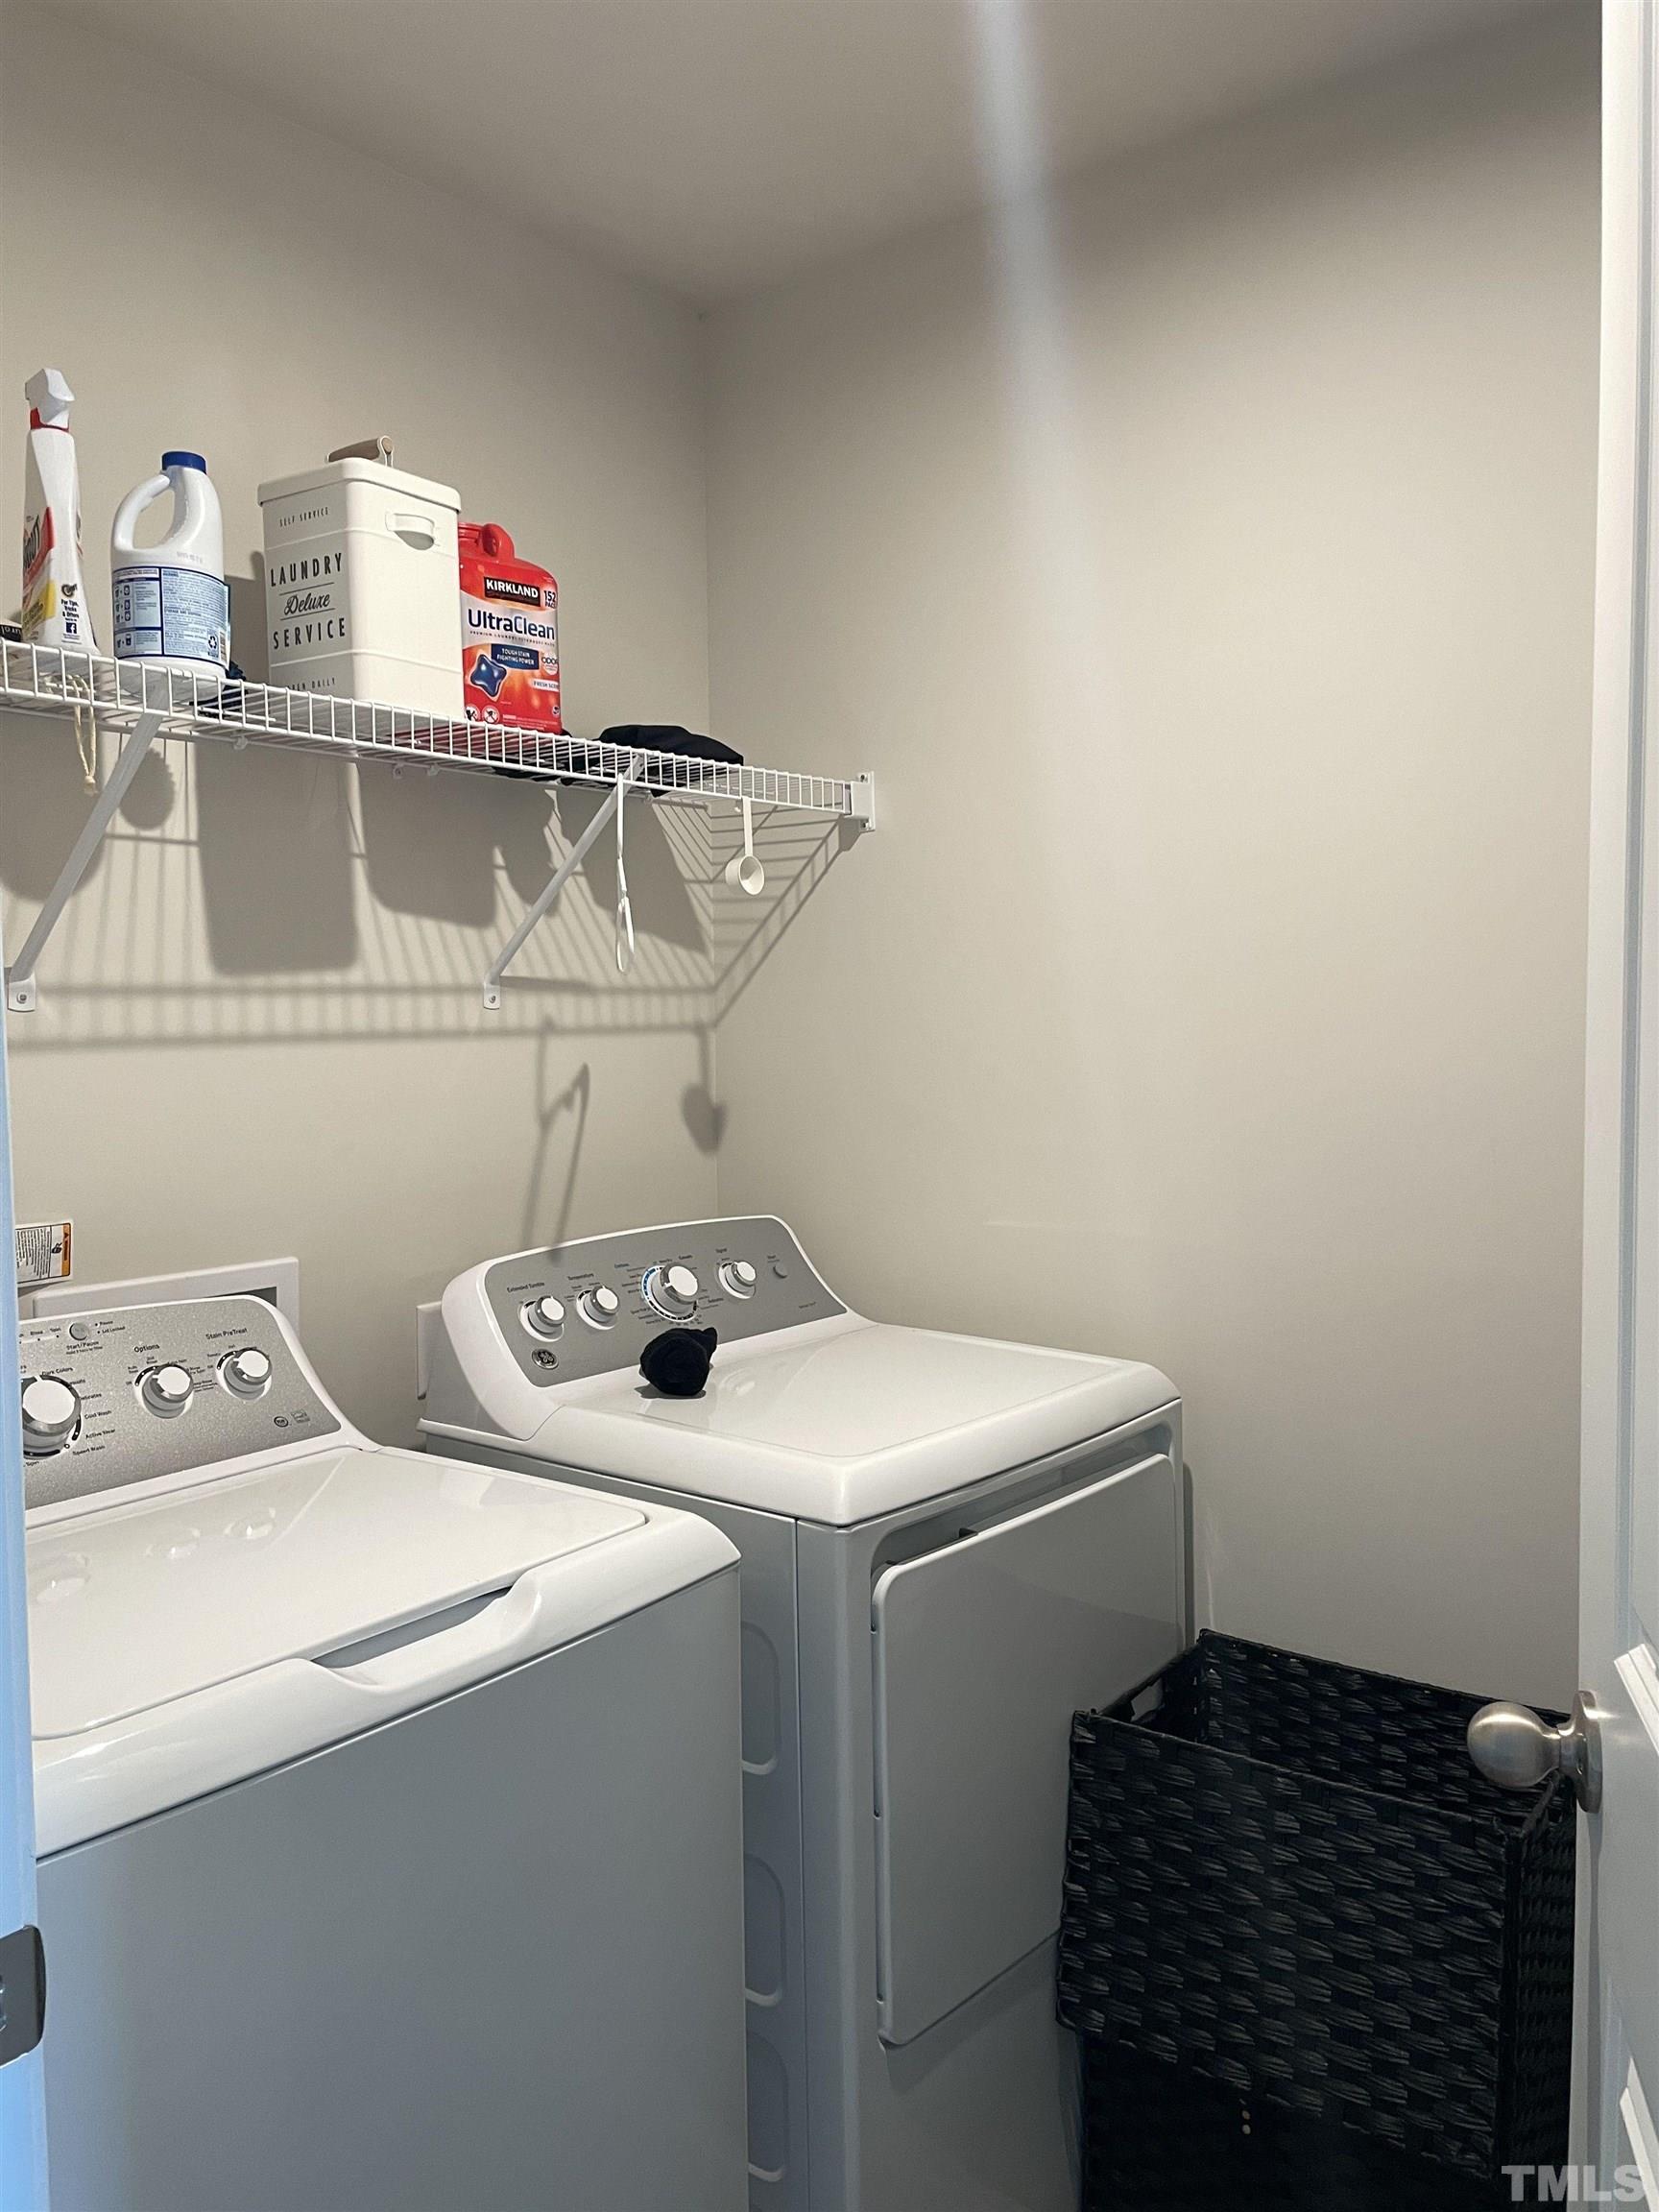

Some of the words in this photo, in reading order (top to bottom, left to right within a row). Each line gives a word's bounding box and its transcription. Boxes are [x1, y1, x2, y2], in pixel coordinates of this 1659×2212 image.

[279, 515, 296, 527] SELF
[300, 506, 328, 521] SERVICE
[270, 552, 343, 587] LAUNDRY
[486, 579, 539, 598] KIRKLAND
[543, 589, 557, 602] 152
[283, 592, 330, 615] Deluxe
[468, 609, 555, 640] UltraClean
[273, 617, 346, 649] SERVICE
[496, 654, 518, 663] FIGHTING
[518, 657, 535, 665] POWER
[311, 677, 335, 688] DAILY
[223, 1328, 248, 1337] PreTreat
[66, 1340, 100, 1351] Start/Pause
[133, 1344, 160, 1354] Options
[85, 1431, 102, 1440] Active
[72, 1448, 90, 1456] Speed
